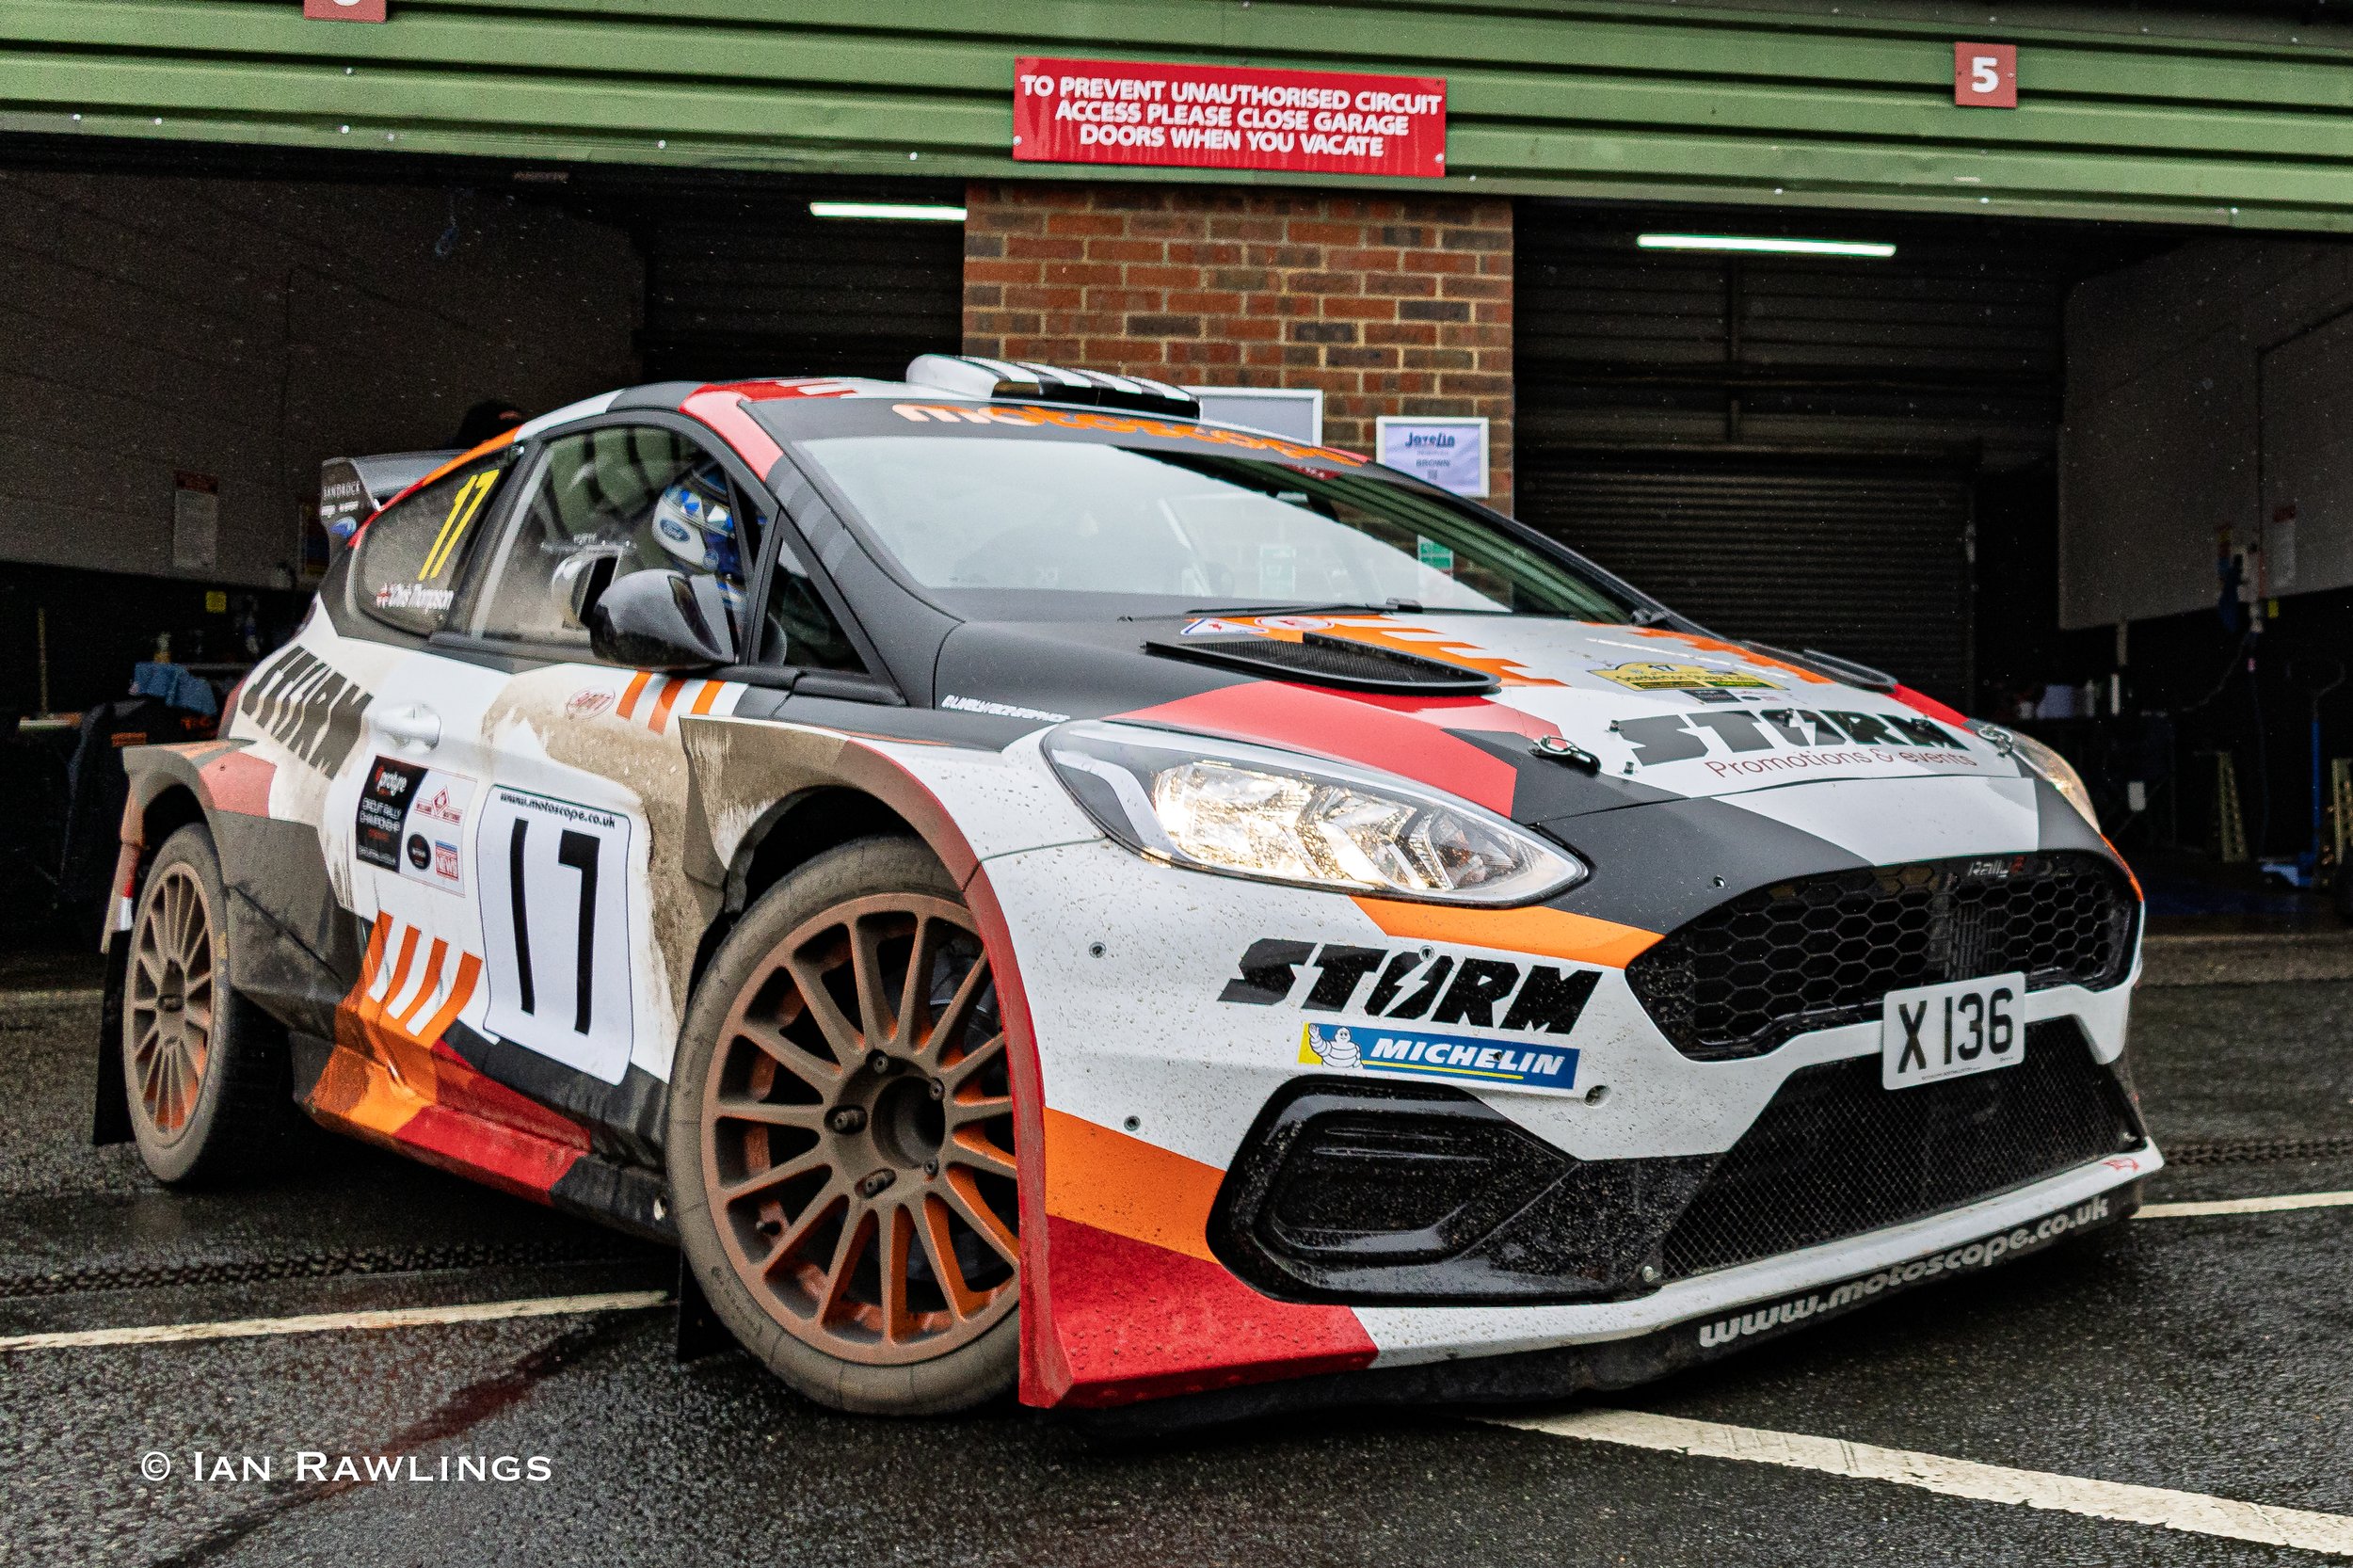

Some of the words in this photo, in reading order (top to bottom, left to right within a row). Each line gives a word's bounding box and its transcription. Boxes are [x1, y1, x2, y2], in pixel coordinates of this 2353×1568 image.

[1020, 74, 1055, 97] TO
[1060, 77, 1166, 103] PREVENT
[1171, 82, 1350, 111] UNAUTHORISED
[1354, 91, 1442, 116] CIRCUIT
[1971, 56, 2000, 93] 5
[1055, 100, 1142, 124] ACCESS
[1147, 104, 1232, 128] PLEASE
[1237, 107, 1310, 131] CLOSE
[1314, 111, 1409, 136] GARAGE
[1080, 124, 1165, 147] DOORS
[1170, 128, 1241, 151] WHEN
[1246, 131, 1295, 154] YOU
[1300, 134, 1385, 158] VACATE
[418, 469, 500, 582] 17
[1617, 708, 1971, 767] STORM
[1704, 748, 1872, 778] Promotions
[1873, 748, 1895, 763] &
[1898, 750, 1977, 768] events
[501, 792, 616, 828] www.motoscope.co.uk
[509, 817, 601, 1036] 17
[1217, 937, 1603, 1035] STORM
[1897, 1000, 1928, 1074] X
[1944, 987, 2014, 1065] 136
[1370, 1038, 1565, 1076] MICHELIN
[1699, 1194, 2109, 1348] www.motoscope.co.uk
